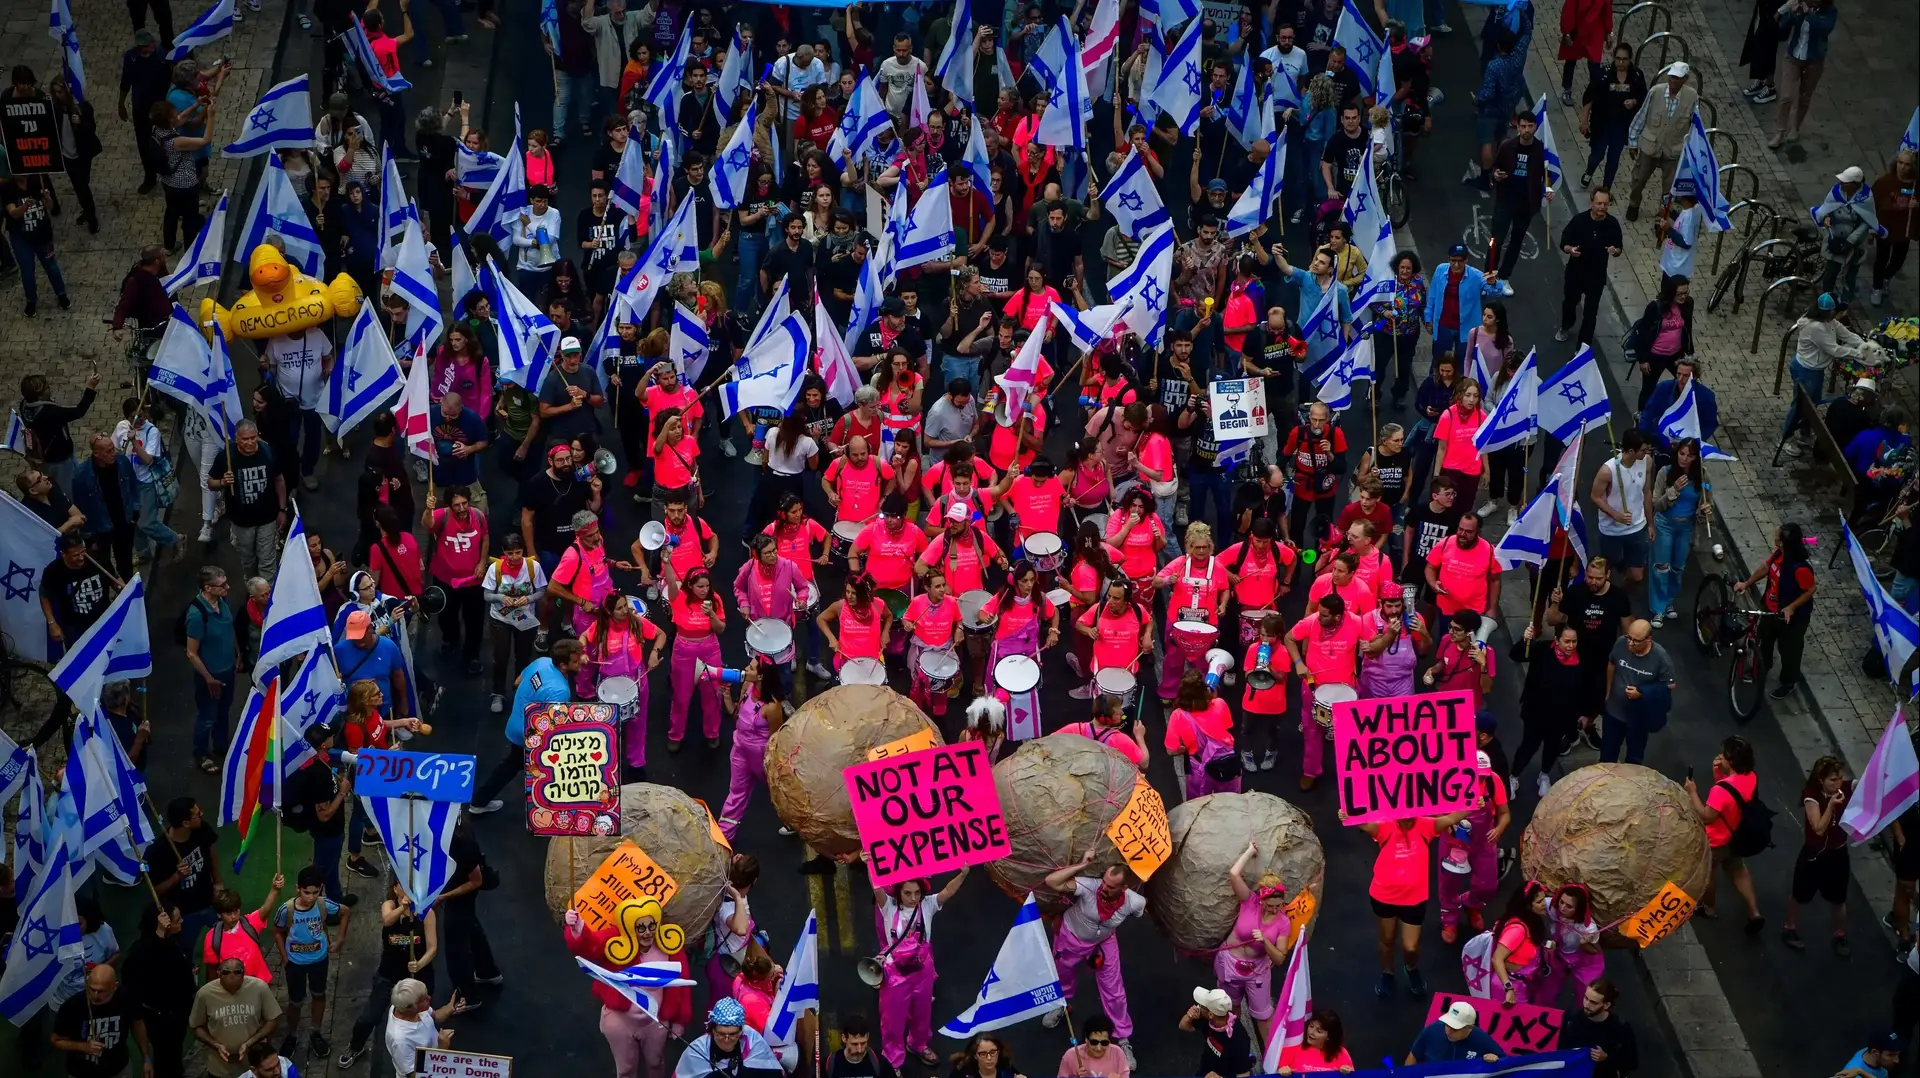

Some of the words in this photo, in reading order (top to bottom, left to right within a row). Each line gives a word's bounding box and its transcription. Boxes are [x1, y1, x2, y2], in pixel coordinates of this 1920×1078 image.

[6, 103, 46, 117] מלחמה
[21, 120, 38, 133] על
[240, 301, 325, 333] DEMOCRACY
[1166, 379, 1190, 393] דמו
[1220, 419, 1249, 430] BEGIN
[1255, 417, 1264, 426] END
[242, 465, 268, 480] דמו
[243, 480, 268, 496] קרט
[245, 493, 259, 505] יה
[1422, 521, 1449, 536] דמו
[1351, 698, 1465, 735] WHAT
[551, 735, 600, 752] מצילים
[564, 753, 587, 764] את
[1345, 732, 1471, 771] ABOUT
[855, 761, 921, 802] NOT
[933, 749, 981, 783] AT
[550, 780, 600, 800] קרטיה
[1344, 767, 1476, 817] LIVING?
[881, 785, 974, 826] OUR
[870, 814, 1005, 876] EXPENSE
[613, 853, 642, 876] מיליון
[633, 866, 674, 903] 285
[1031, 984, 1056, 997] חופשי
[1033, 991, 1059, 1005] בארצנו
[215, 1003, 256, 1018] AMERICAN
[223, 1014, 249, 1027] EAGLE
[430, 1053, 447, 1063] we
[453, 1056, 472, 1065] are
[479, 1058, 498, 1068] the
[433, 1063, 456, 1075] Iron
[466, 1067, 500, 1078] Dome
